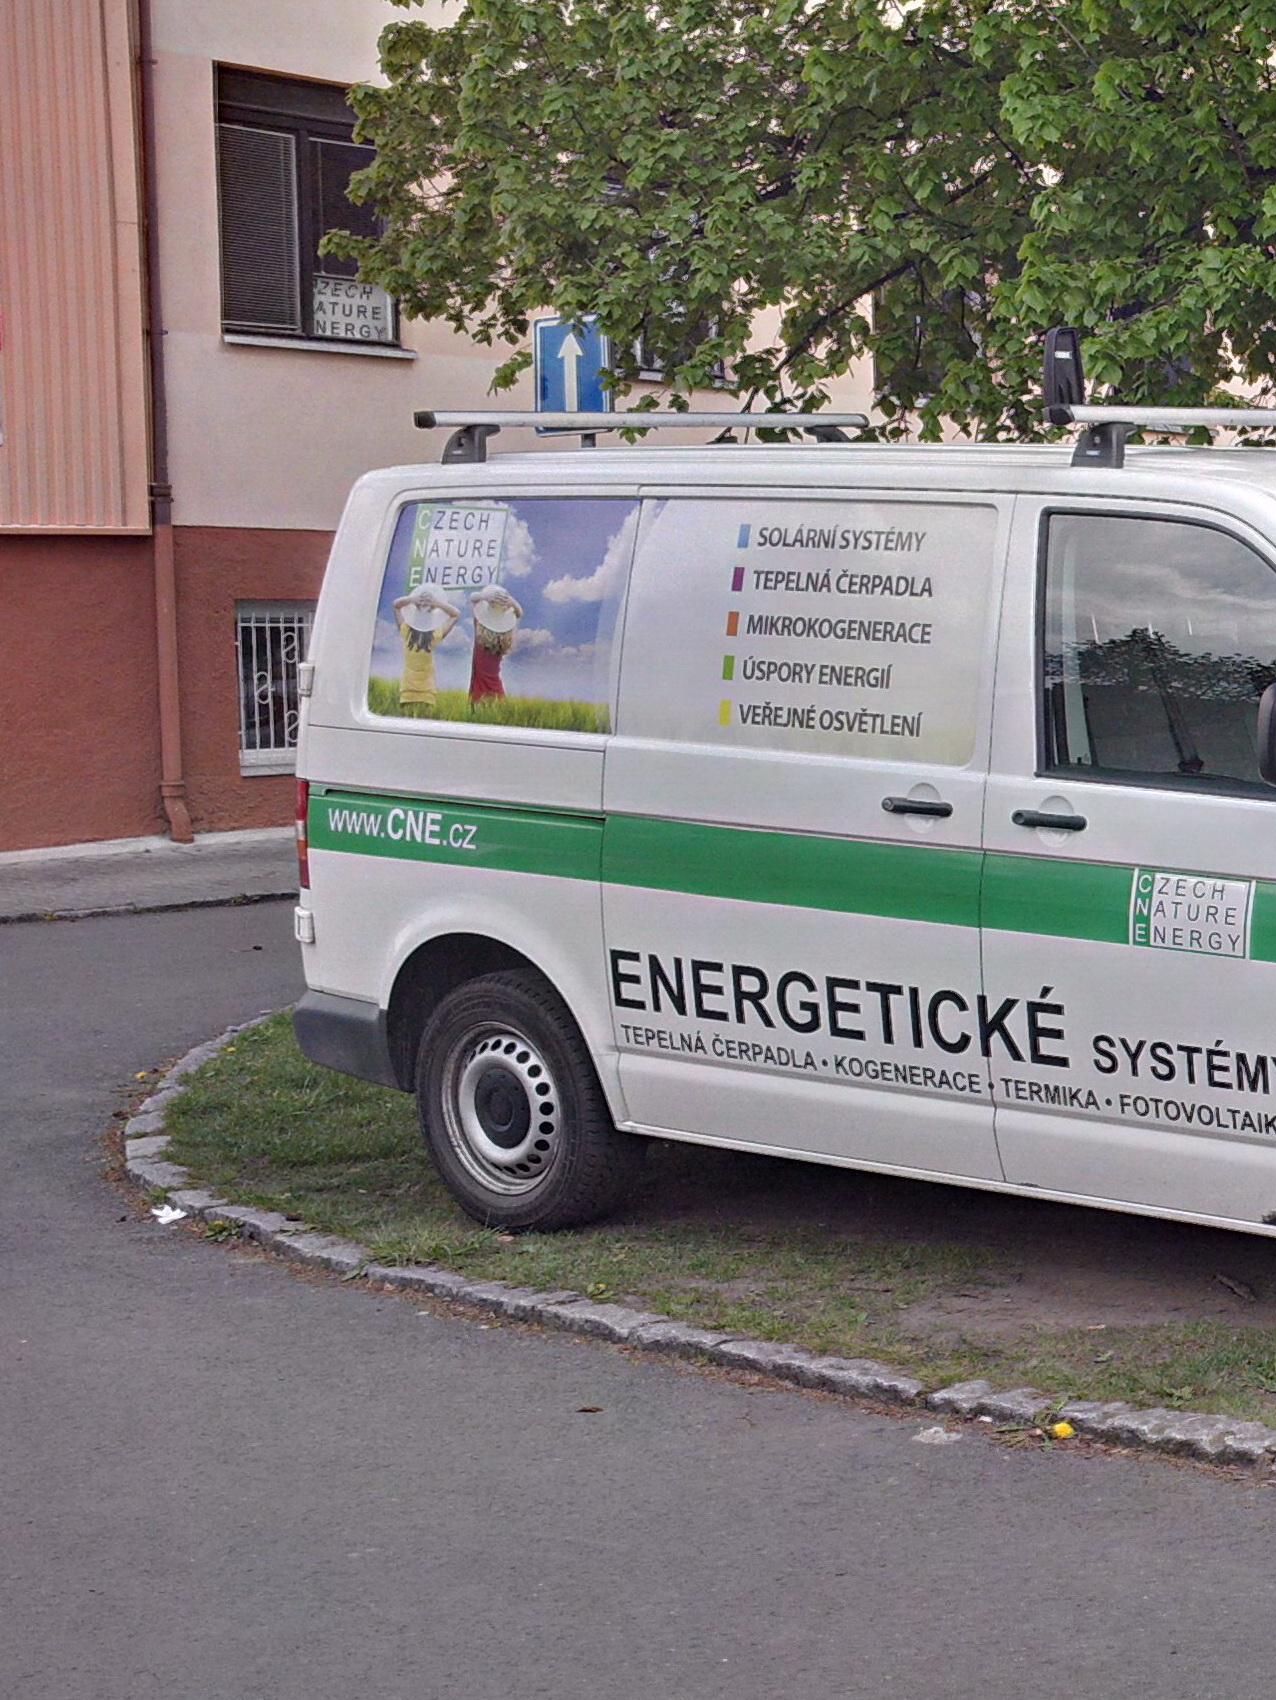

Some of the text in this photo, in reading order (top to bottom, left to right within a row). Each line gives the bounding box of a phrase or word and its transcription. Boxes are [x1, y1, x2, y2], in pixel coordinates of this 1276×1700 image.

[418, 509, 490, 530] CZECH
[413, 539, 497, 558] NATURE
[757, 524, 927, 552] SOLÁRNÍ SYSTÉMY
[409, 565, 497, 587] ENERGY
[753, 568, 933, 598] TEPELNÁ ČERPADLA
[746, 614, 932, 644] MIKROKOGENERACE
[742, 656, 893, 690] ÚSPORY ENERGIÍ
[739, 701, 924, 738] VEŘEJNÉ OSVĚTLENÍ
[1138, 874, 1226, 901] CZECH
[1135, 897, 1238, 926] NATURE
[1134, 923, 1241, 952] ENERGY
[609, 948, 1070, 1068] ENERGETICKÉ
[620, 1024, 708, 1055] TEPELNÁ
[711, 1033, 818, 1072] ČERPADLA
[833, 1054, 983, 1094] KOGENERACE
[1000, 1077, 1100, 1112] TERMIKA
